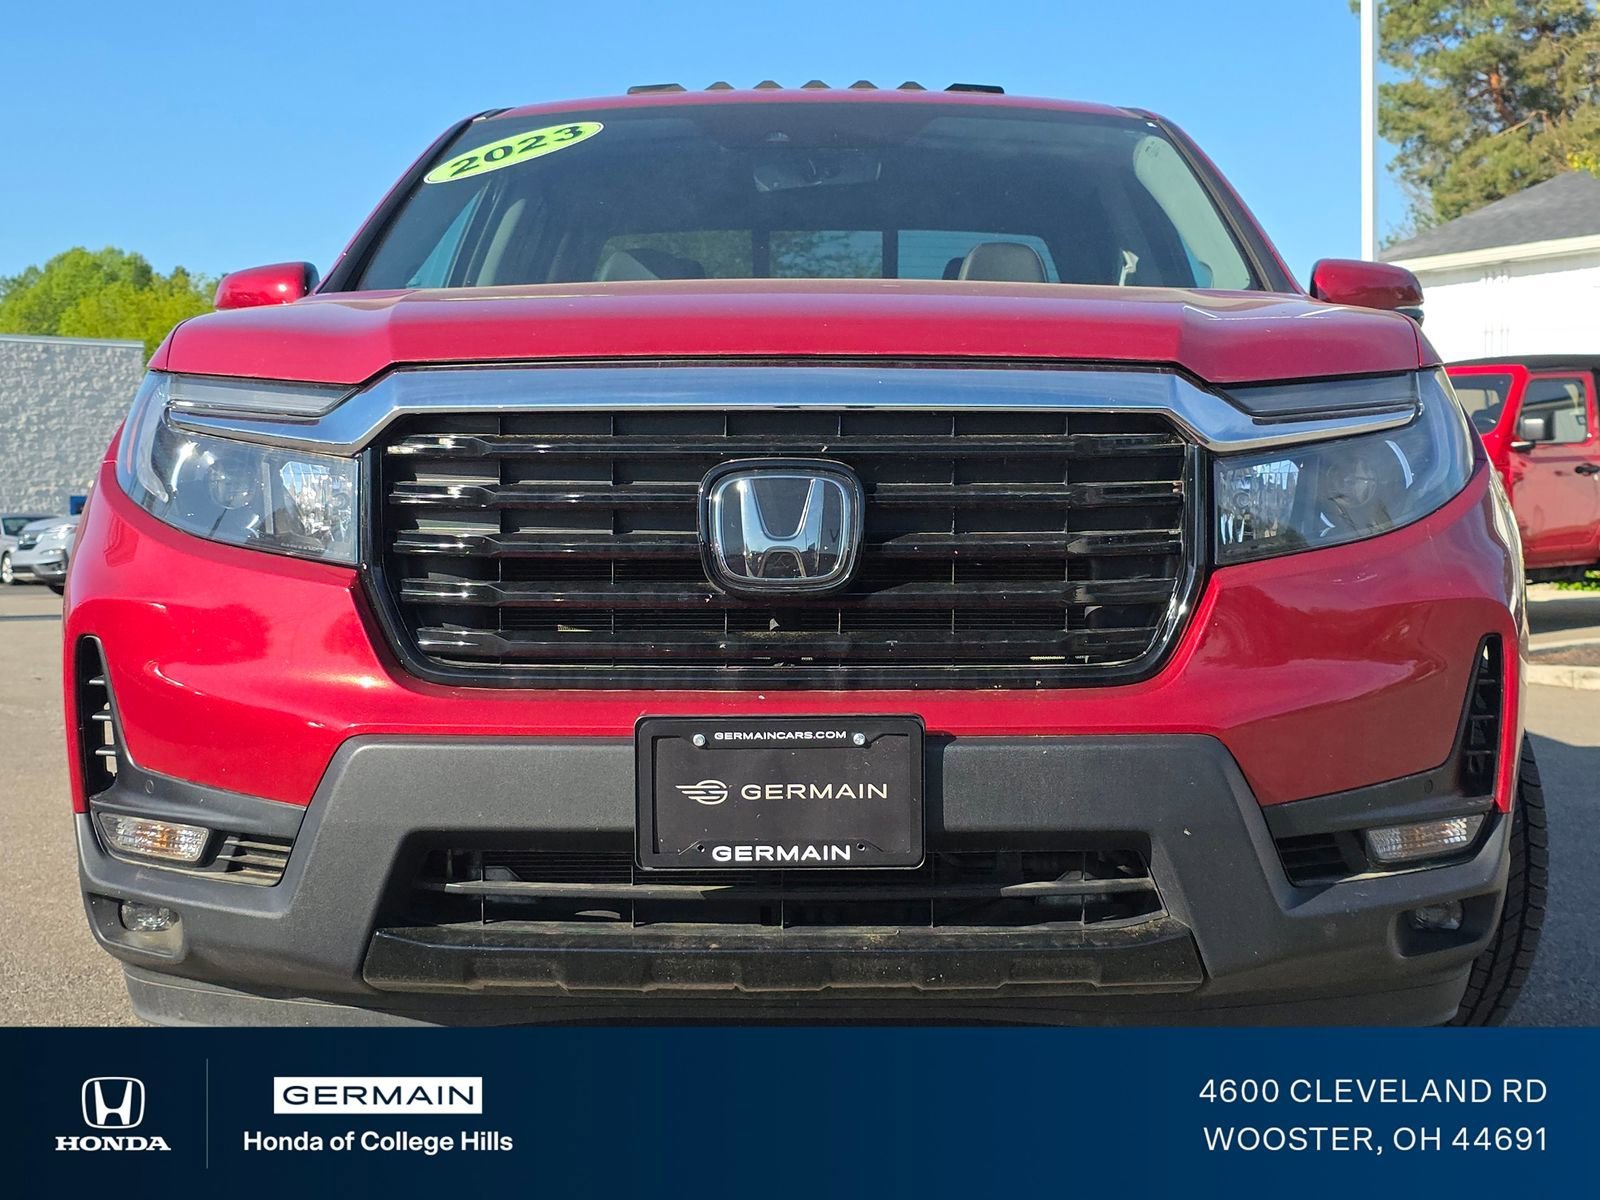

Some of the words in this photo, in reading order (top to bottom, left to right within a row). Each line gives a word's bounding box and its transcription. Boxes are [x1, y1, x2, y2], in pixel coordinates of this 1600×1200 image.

[449, 125, 584, 178] 2023
[713, 730, 847, 741] GERMAINCARS.COM
[740, 783, 888, 801] GERMAIN
[711, 844, 851, 863] GERMAIN
